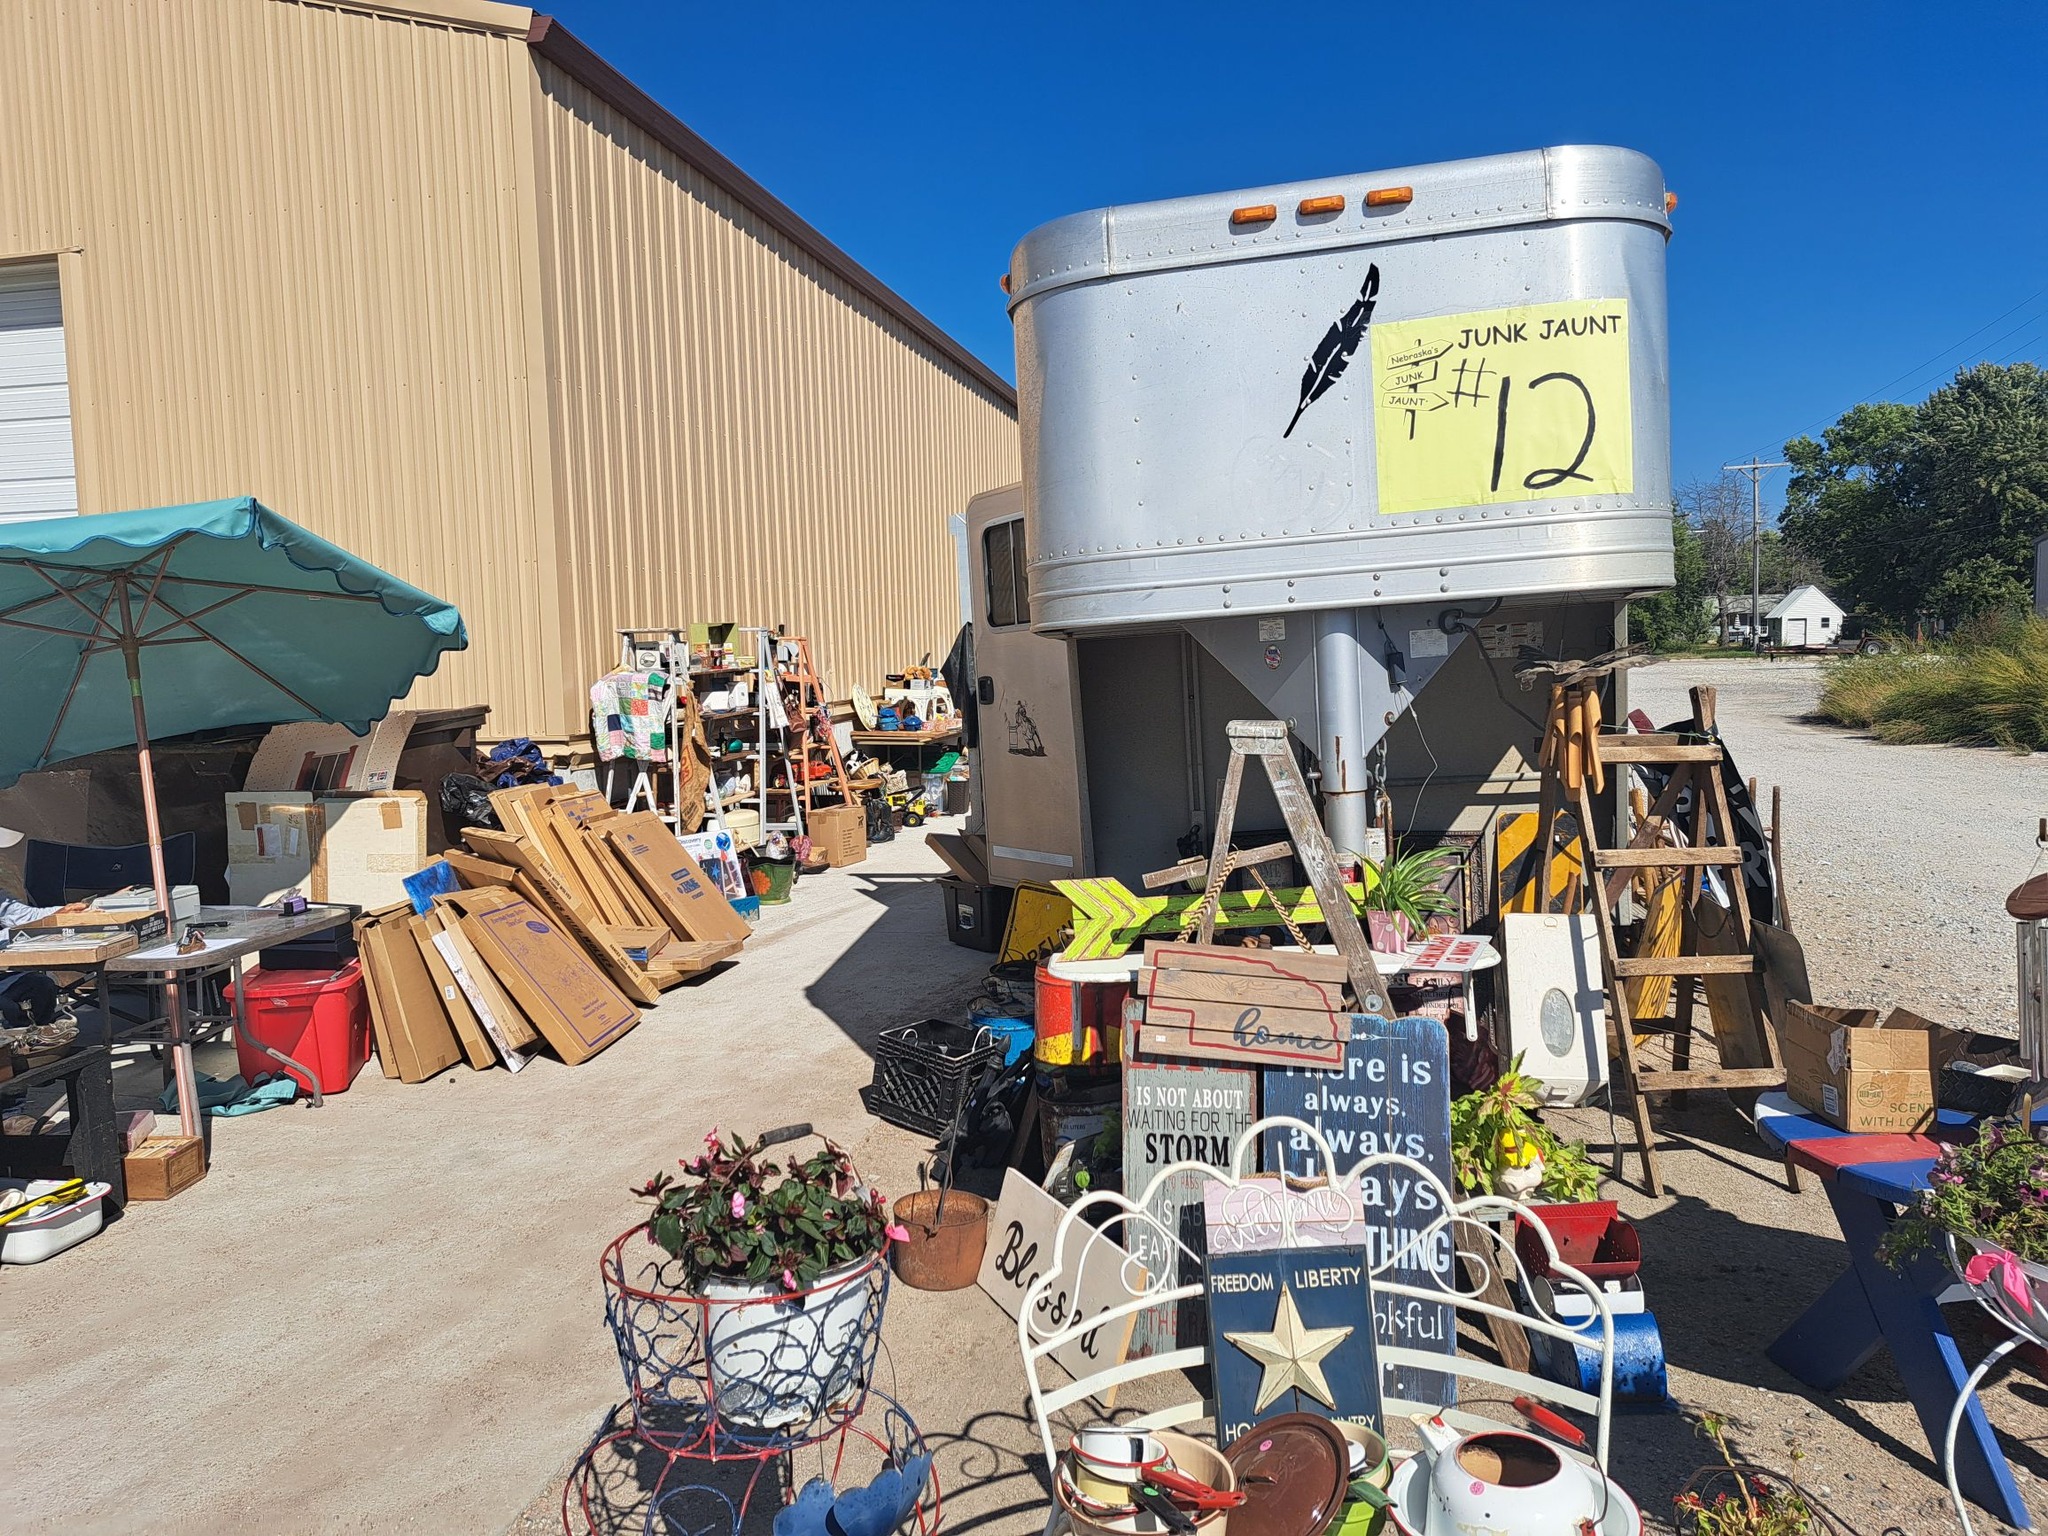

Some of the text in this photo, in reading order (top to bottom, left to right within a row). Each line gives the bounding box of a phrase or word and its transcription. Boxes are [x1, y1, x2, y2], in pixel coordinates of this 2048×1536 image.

[1458, 315, 1622, 349] JUNK JAUNT
[1390, 347, 1439, 365] Nebraska's
[1394, 370, 1424, 386] JUNK
[1388, 395, 1426, 406] JAUNT
[534, 879, 565, 912] DANCES
[564, 914, 583, 934] WITH
[582, 936, 614, 968] WOLVES
[1233, 1007, 1333, 1050] home
[1401, 1053, 1432, 1085] is
[1136, 1086, 1243, 1109] IS NOT ABOUT
[1304, 1085, 1406, 1119] always,
[1890, 1103, 1934, 1113] SCENT
[1128, 1108, 1253, 1134] WAITING FOR THE
[1860, 1116, 1893, 1127] WITH
[1145, 1133, 1230, 1167] STORM
[1180, 1176, 1199, 1190] PASS
[1157, 1199, 1173, 1226] IS
[1210, 1266, 1361, 1293] FREEDOM LIBERTY
[1147, 1308, 1179, 1336] THE
[1374, 1300, 1444, 1340] nkful
[1225, 1422, 1256, 1442] HO
